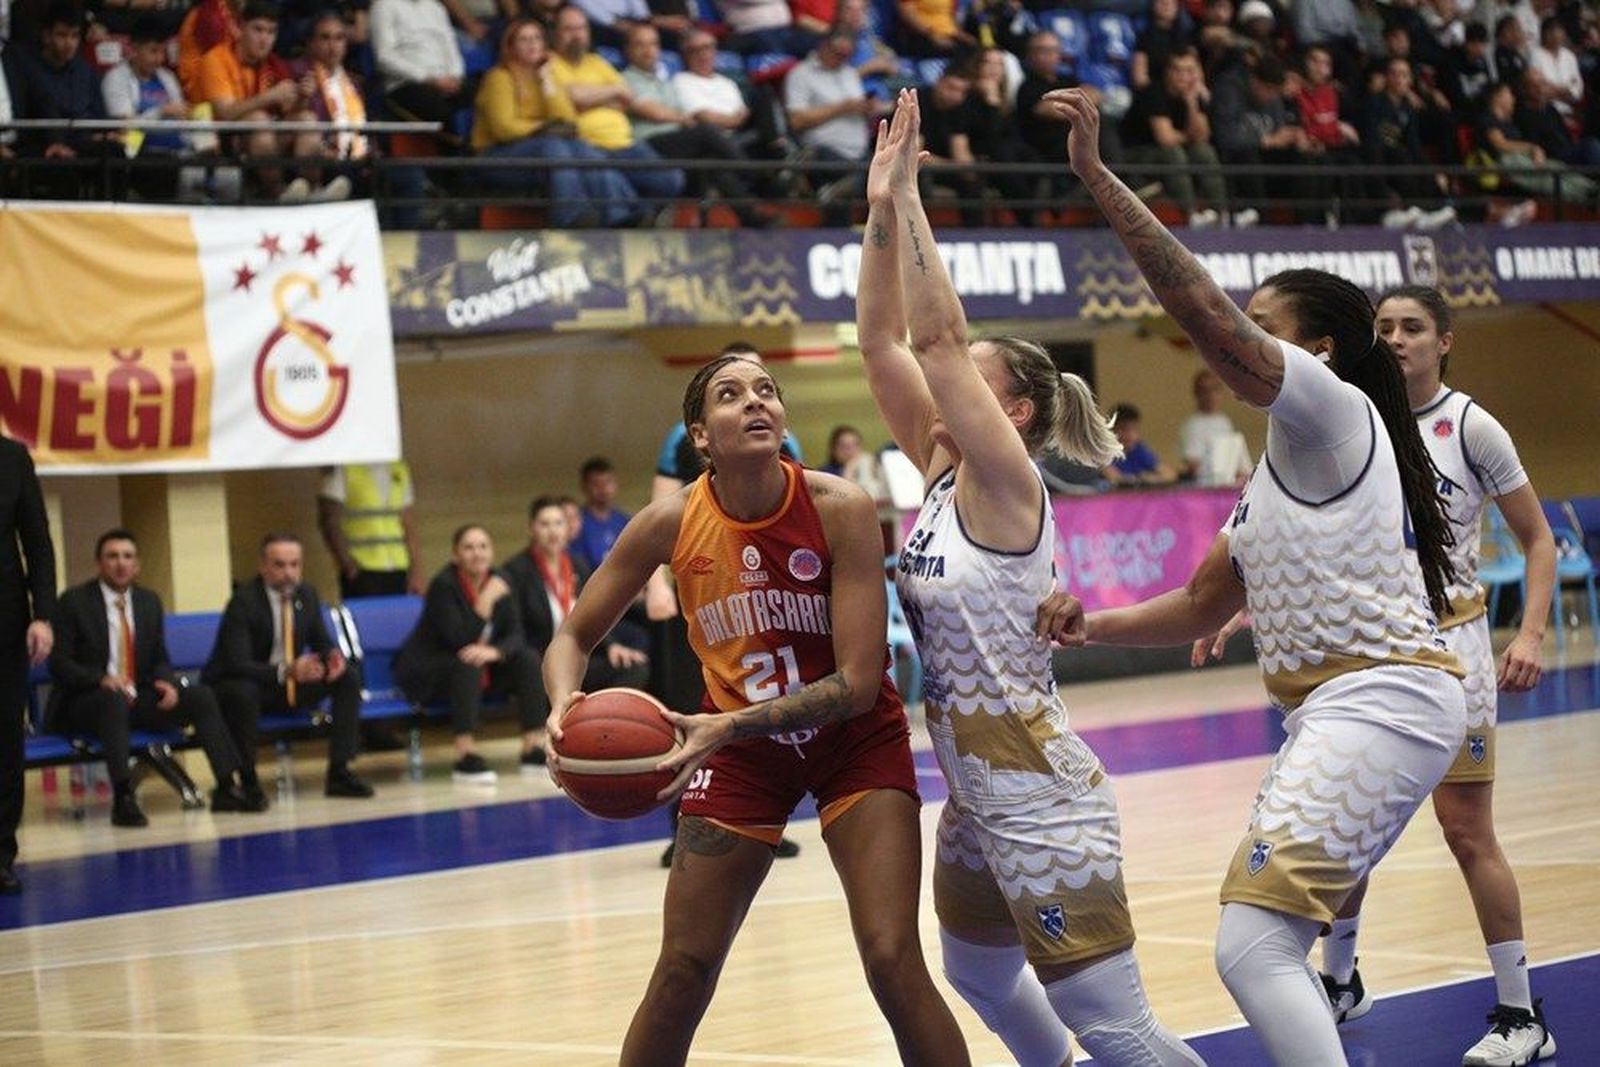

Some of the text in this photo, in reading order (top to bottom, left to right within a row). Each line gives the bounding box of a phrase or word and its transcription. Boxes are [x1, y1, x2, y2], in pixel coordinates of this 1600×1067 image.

[808, 242, 1067, 305] COTANȚA
[1194, 252, 1252, 290] SM
[1496, 247, 1514, 281] O
[1514, 247, 1576, 281] MARE
[696, 588, 832, 646] GALATASARA
[741, 645, 806, 703] 21
[687, 769, 713, 790] DI
